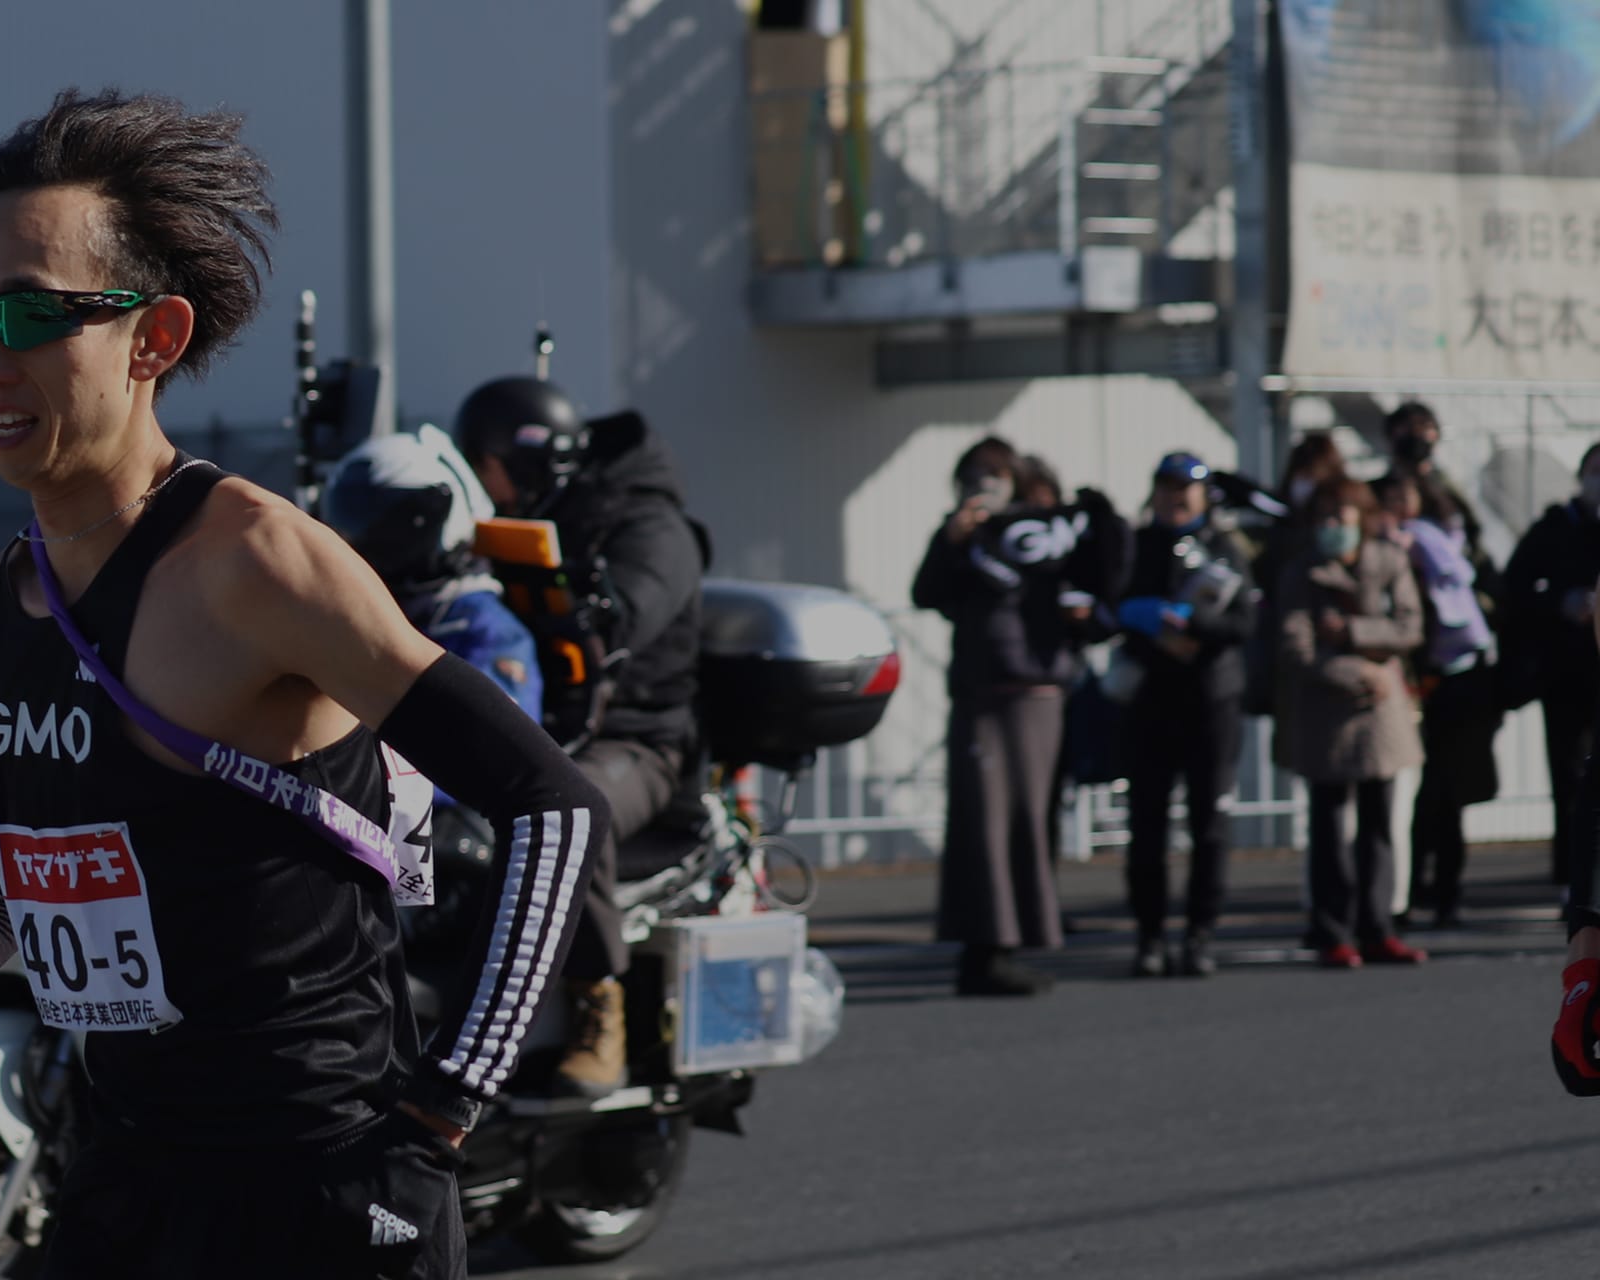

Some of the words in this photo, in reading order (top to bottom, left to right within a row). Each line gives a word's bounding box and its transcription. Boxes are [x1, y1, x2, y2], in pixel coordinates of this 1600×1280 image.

[1457, 290, 1600, 352] 大日本
[12, 847, 126, 889] ヤマザキ
[19, 912, 150, 993] 40-5
